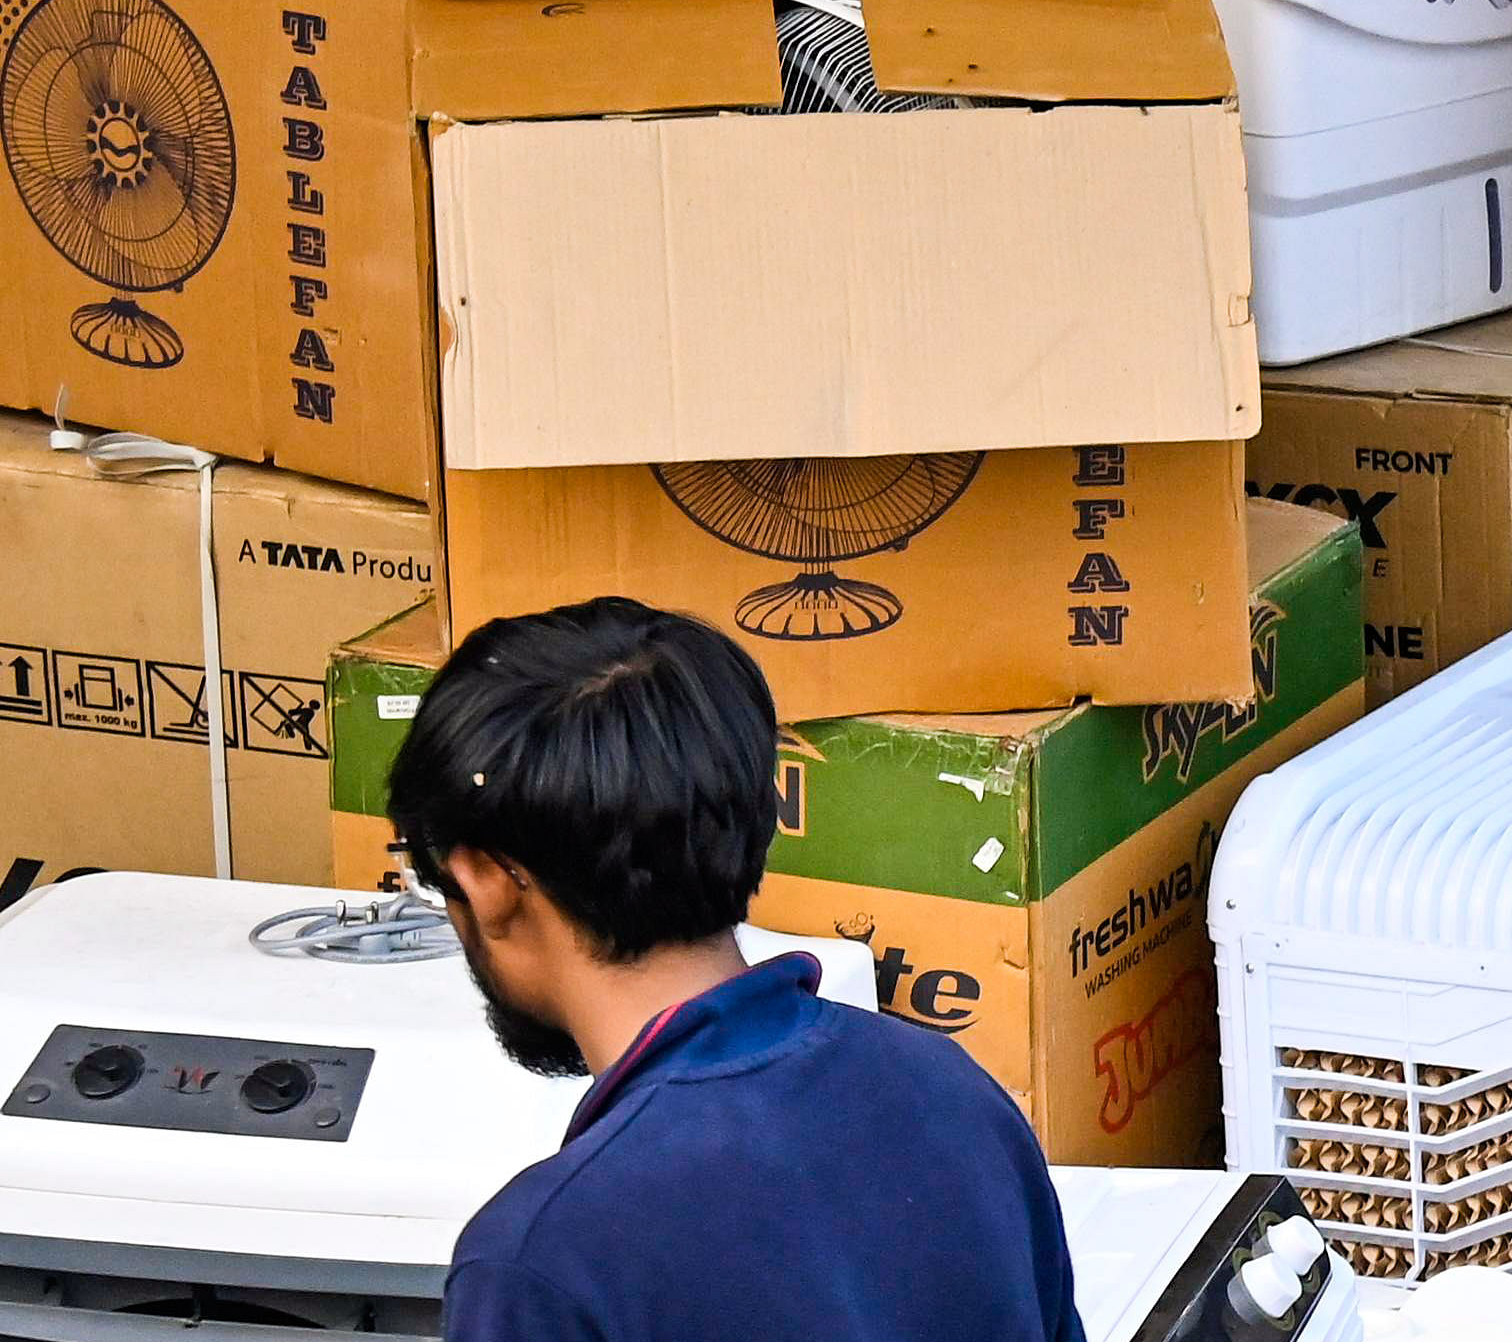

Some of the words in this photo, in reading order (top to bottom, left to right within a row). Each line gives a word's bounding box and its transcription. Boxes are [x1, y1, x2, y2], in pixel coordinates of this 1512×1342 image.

[1355, 448, 1453, 475] FRONT
[239, 539, 256, 564] A
[261, 541, 345, 573] TATA
[353, 551, 432, 582] Produ
[1067, 445, 1132, 649] EFAN
[64, 712, 90, 724] max.
[94, 714, 121, 726] 1000
[123, 716, 138, 729] kg
[1069, 861, 1194, 979] freshwa
[1085, 951, 1142, 1000] WASHING
[1142, 910, 1194, 956] MACHINE
